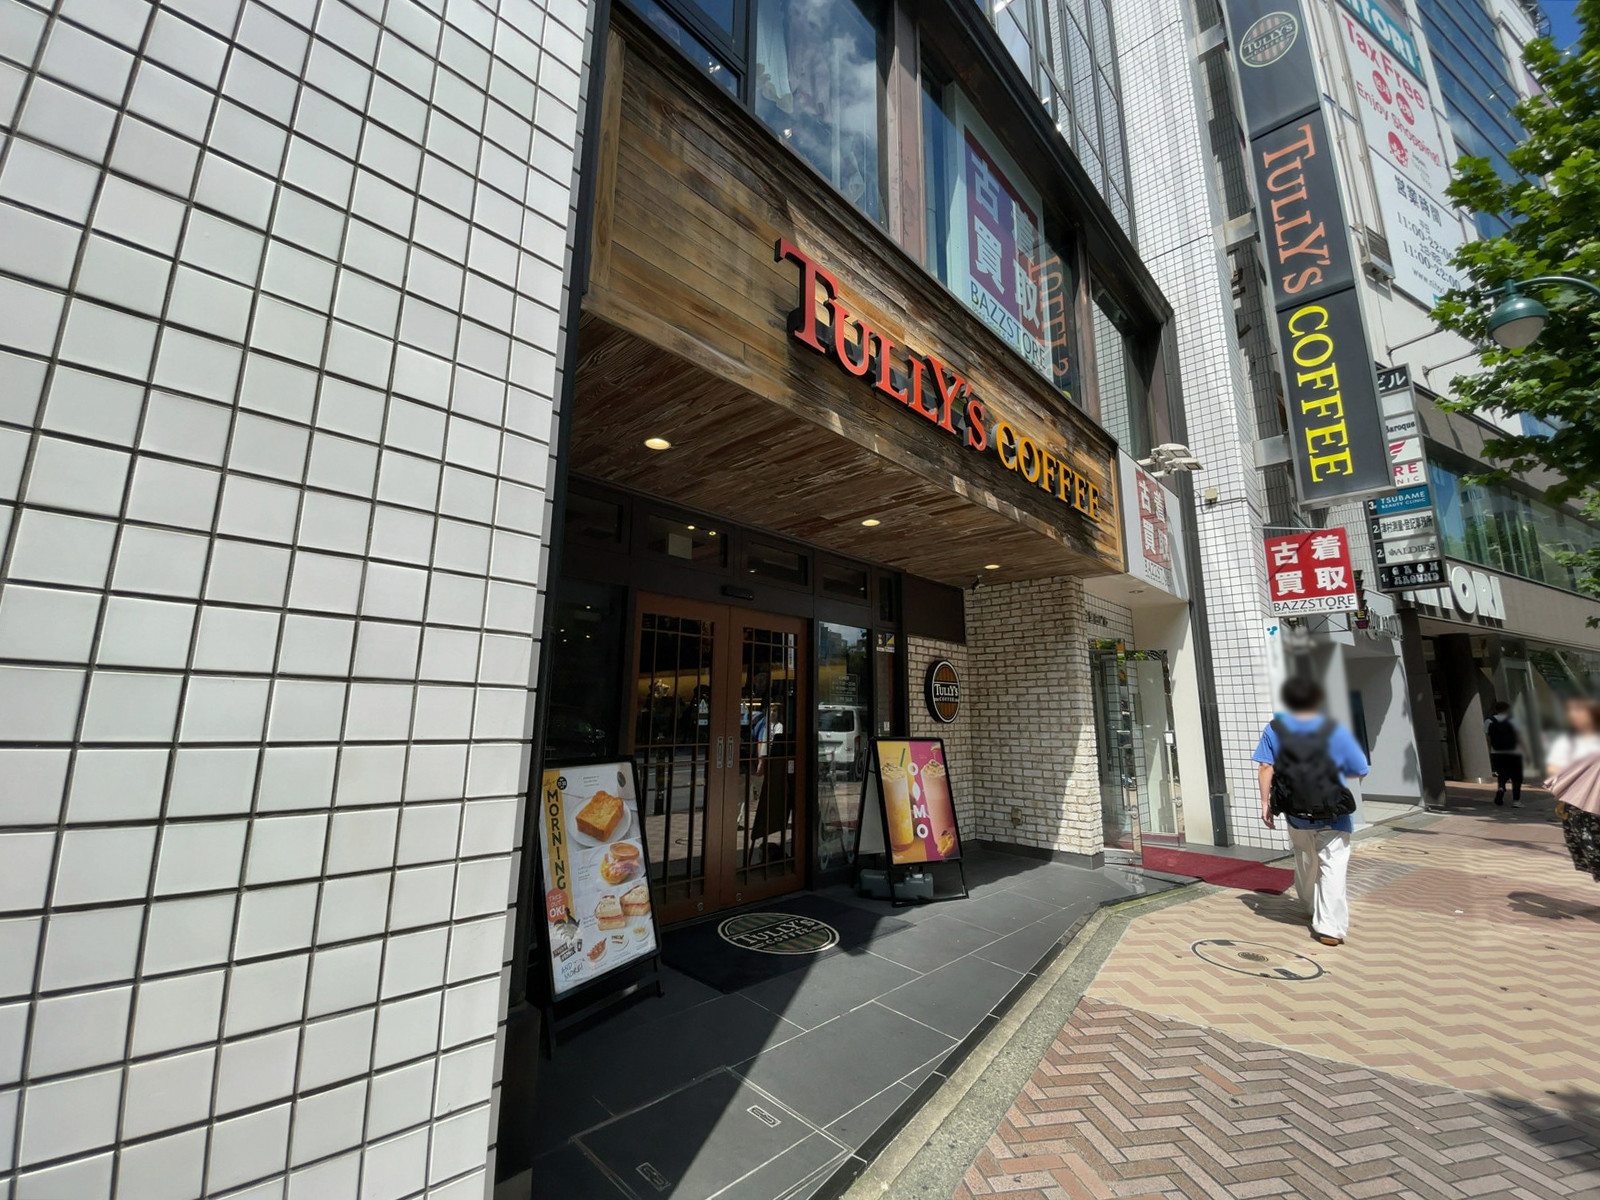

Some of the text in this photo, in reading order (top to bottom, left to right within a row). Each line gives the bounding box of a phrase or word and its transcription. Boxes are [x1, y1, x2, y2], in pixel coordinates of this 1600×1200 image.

[1243, 23, 1293, 54] TULLY'S
[1341, 13, 1381, 70] Tax
[1380, 51, 1425, 111] Free
[1356, 80, 1388, 121] Enjoy
[1263, 123, 1331, 295] TULLY'S
[974, 214, 1041, 331] 買取
[777, 237, 988, 452] TULLY'S
[971, 281, 1046, 369] BAZZSTORE
[1288, 305, 1353, 483] COFFEE
[996, 420, 1102, 522] COFFEE
[1380, 490, 1426, 505] TSUBAME
[1270, 534, 1341, 567] 古着
[1275, 565, 1348, 597] 買取
[1273, 594, 1356, 612] BAZZSTORE
[934, 683, 959, 697] TULLY'S
[546, 789, 567, 891] MORNING
[549, 905, 566, 918] OK!
[732, 919, 816, 945] TULLY'S
